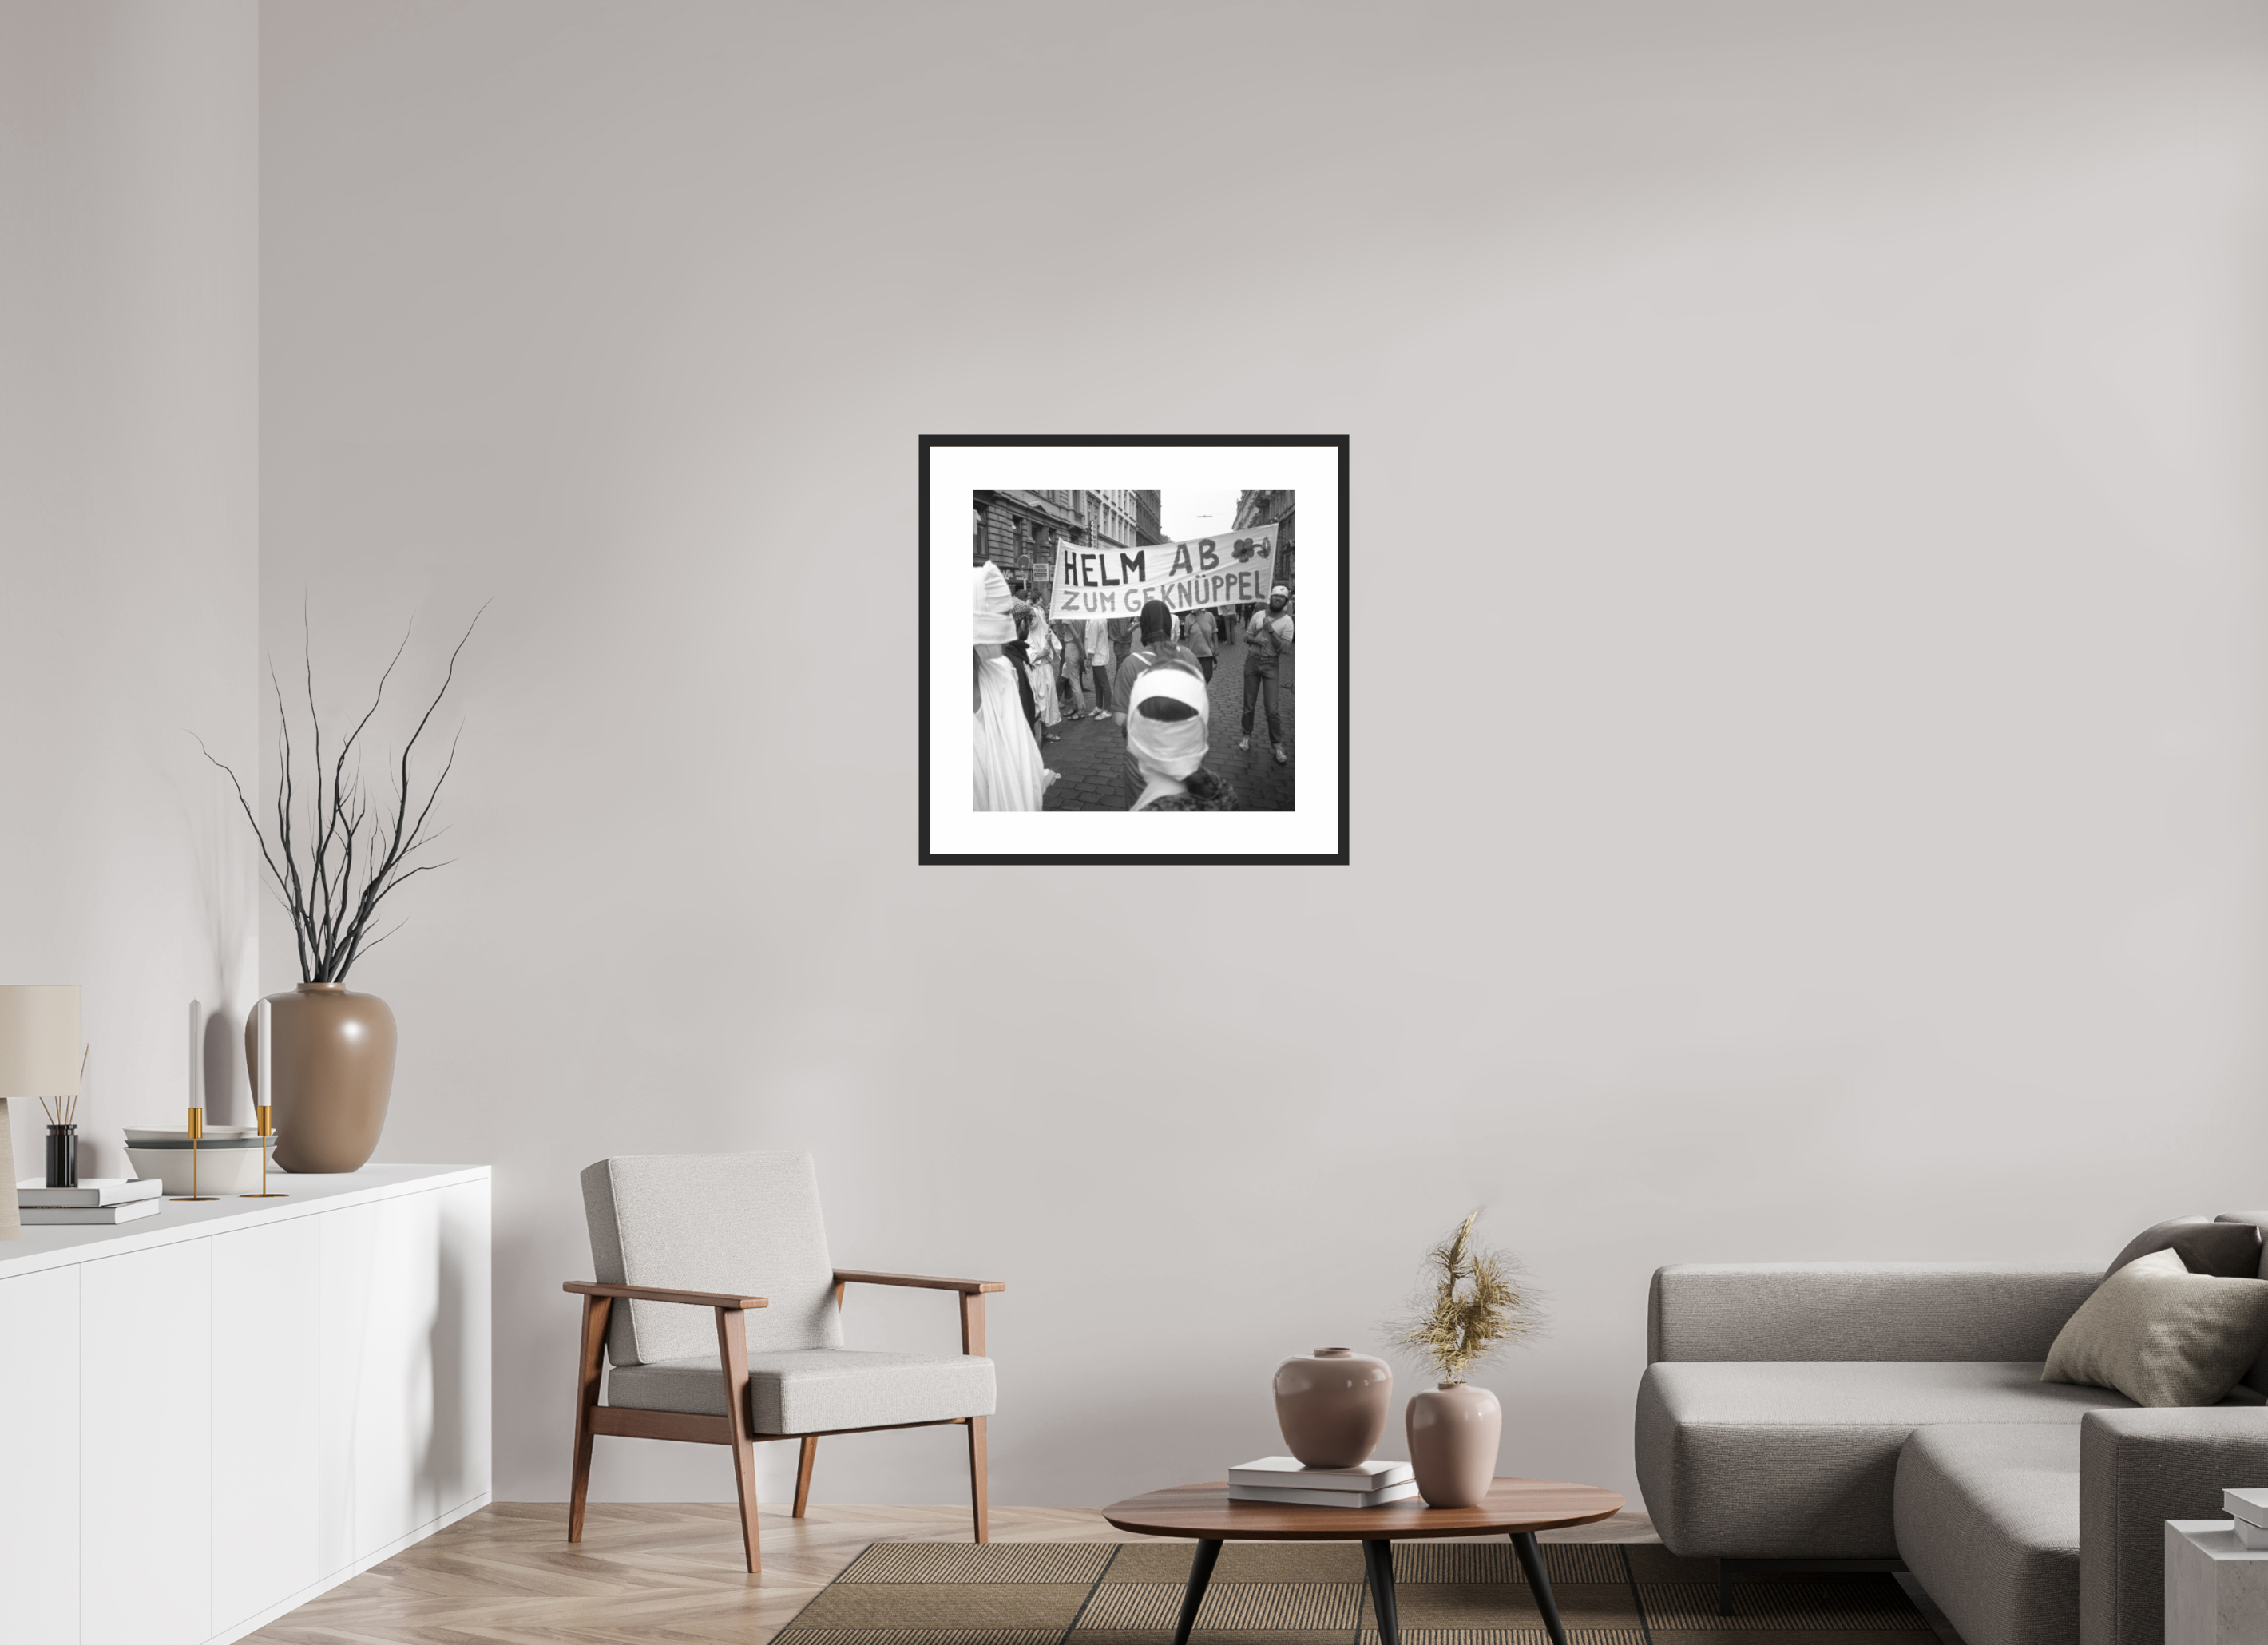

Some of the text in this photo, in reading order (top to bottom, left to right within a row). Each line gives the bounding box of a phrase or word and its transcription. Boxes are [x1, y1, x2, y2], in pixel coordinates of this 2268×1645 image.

[1065, 538, 1219, 587] HELM AB
[1061, 570, 1266, 612] ZUM GEKNÜPPEL
